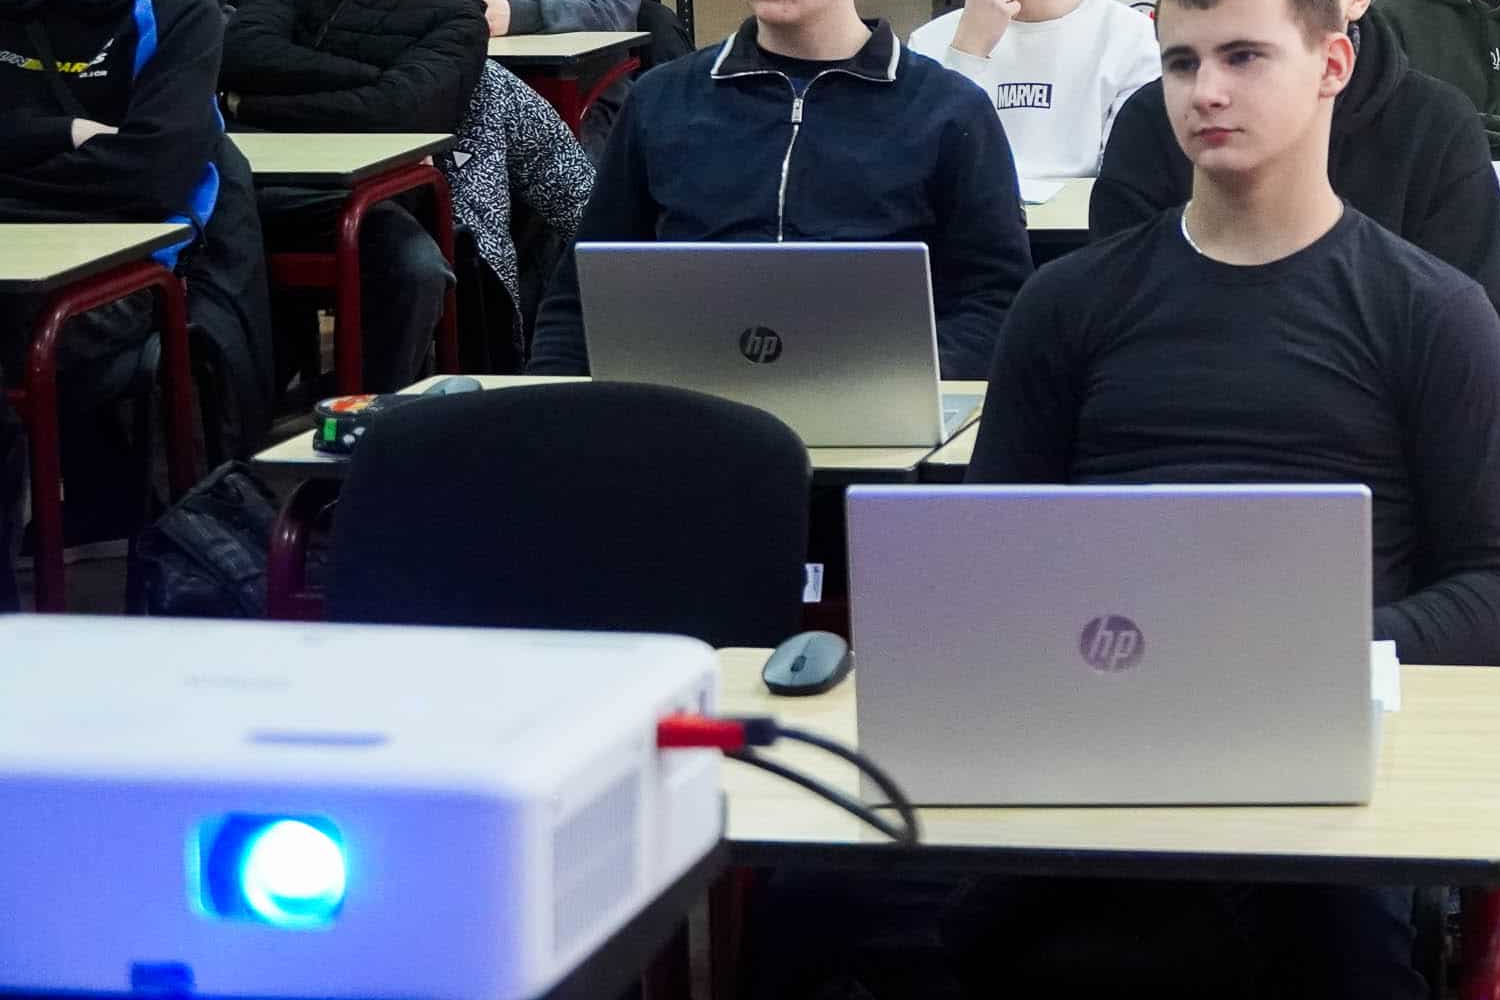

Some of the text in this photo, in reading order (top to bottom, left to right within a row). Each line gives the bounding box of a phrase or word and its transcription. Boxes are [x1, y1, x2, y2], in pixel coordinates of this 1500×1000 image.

[998, 84, 1050, 109] MARVEL
[742, 327, 780, 363] hp
[1085, 615, 1140, 672] hp
